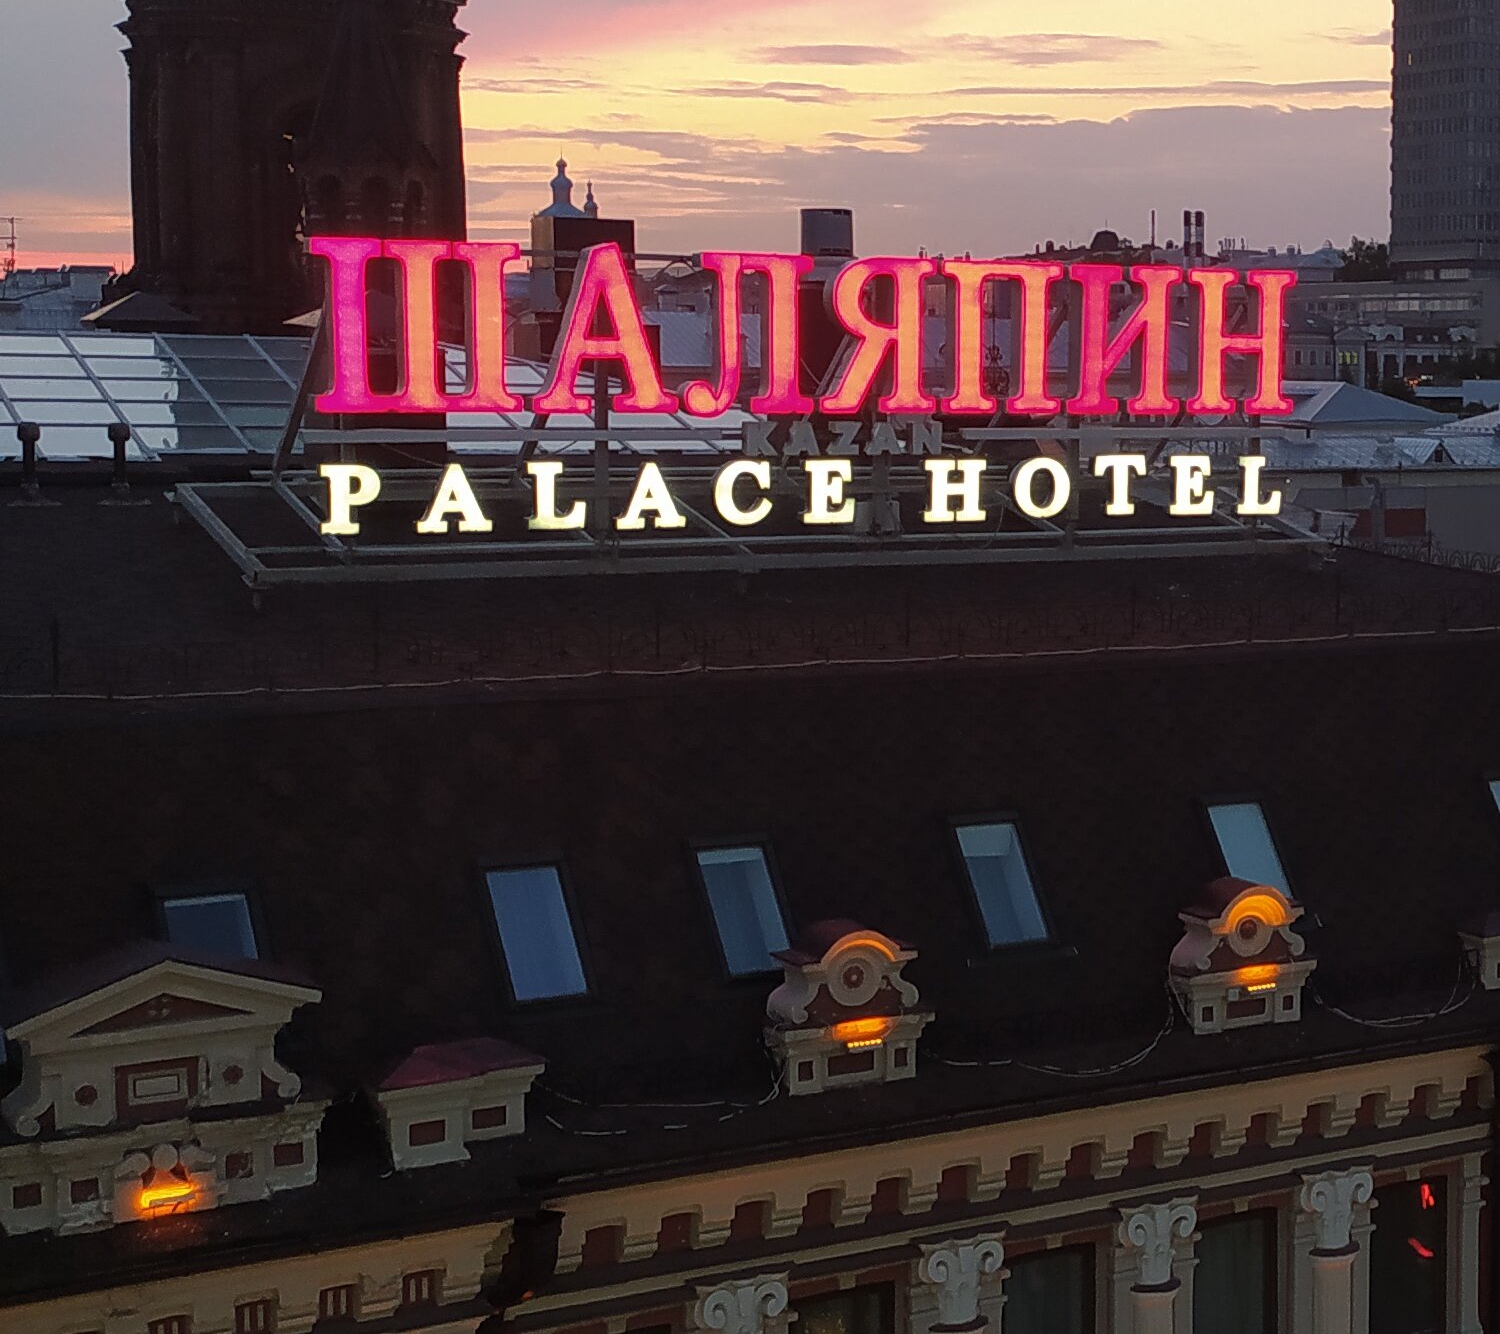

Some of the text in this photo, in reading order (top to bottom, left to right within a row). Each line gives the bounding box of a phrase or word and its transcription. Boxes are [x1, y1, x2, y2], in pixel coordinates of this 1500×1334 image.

[307, 236, 1297, 416] ШАЛЯПИН
[742, 420, 943, 456] KAZAN
[319, 454, 1283, 534] PALACE HOTEL
